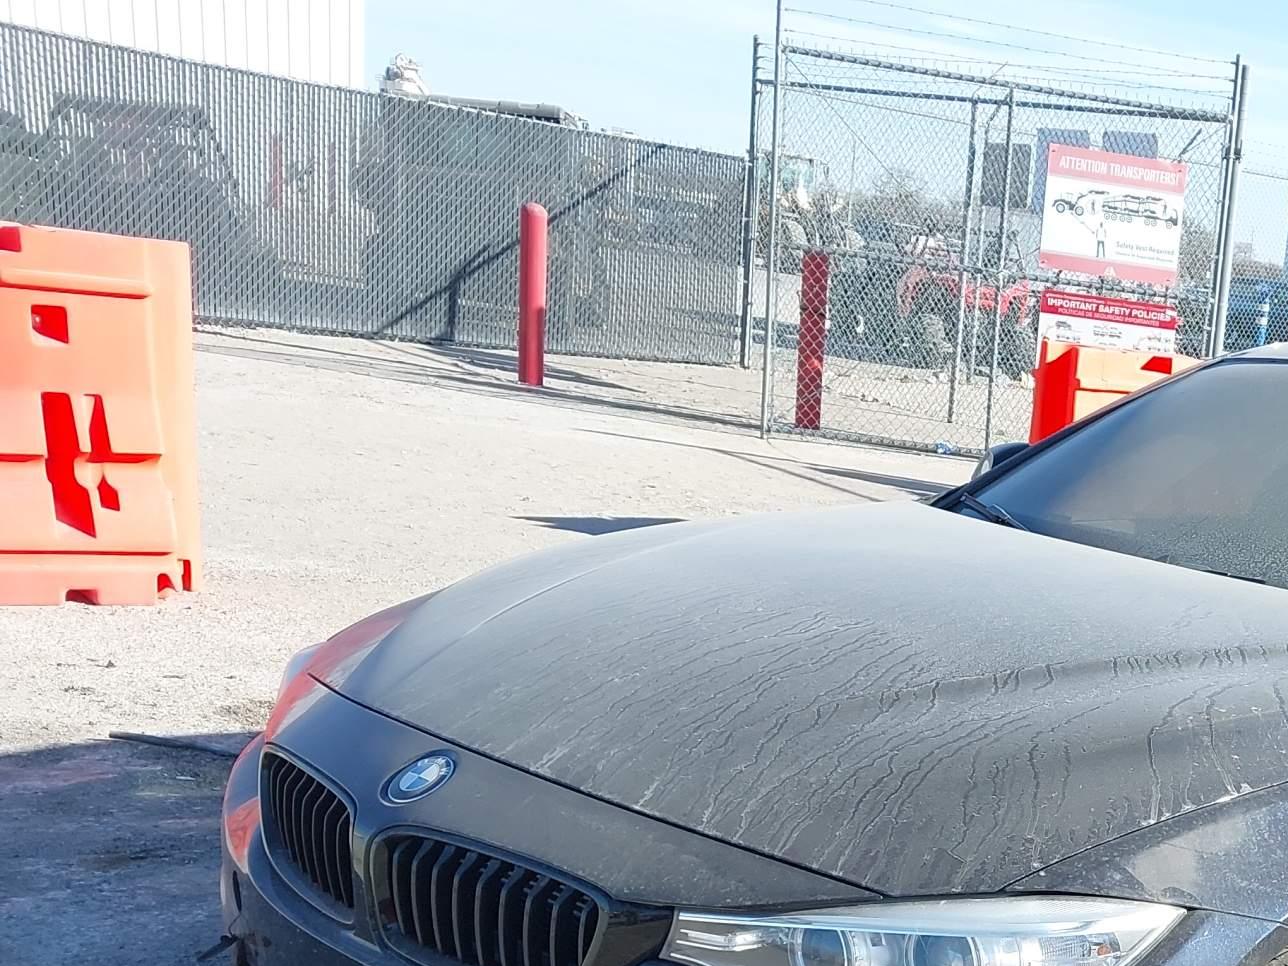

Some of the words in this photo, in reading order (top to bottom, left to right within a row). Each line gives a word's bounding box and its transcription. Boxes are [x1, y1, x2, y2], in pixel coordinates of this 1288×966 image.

[1059, 155, 1108, 175] ATTENTION
[1110, 162, 1180, 186] TRANSPORTERS!
[1047, 297, 1097, 312] IMPORTANT
[1098, 304, 1131, 317] SAFETY
[1131, 309, 1171, 322] POLICIES
